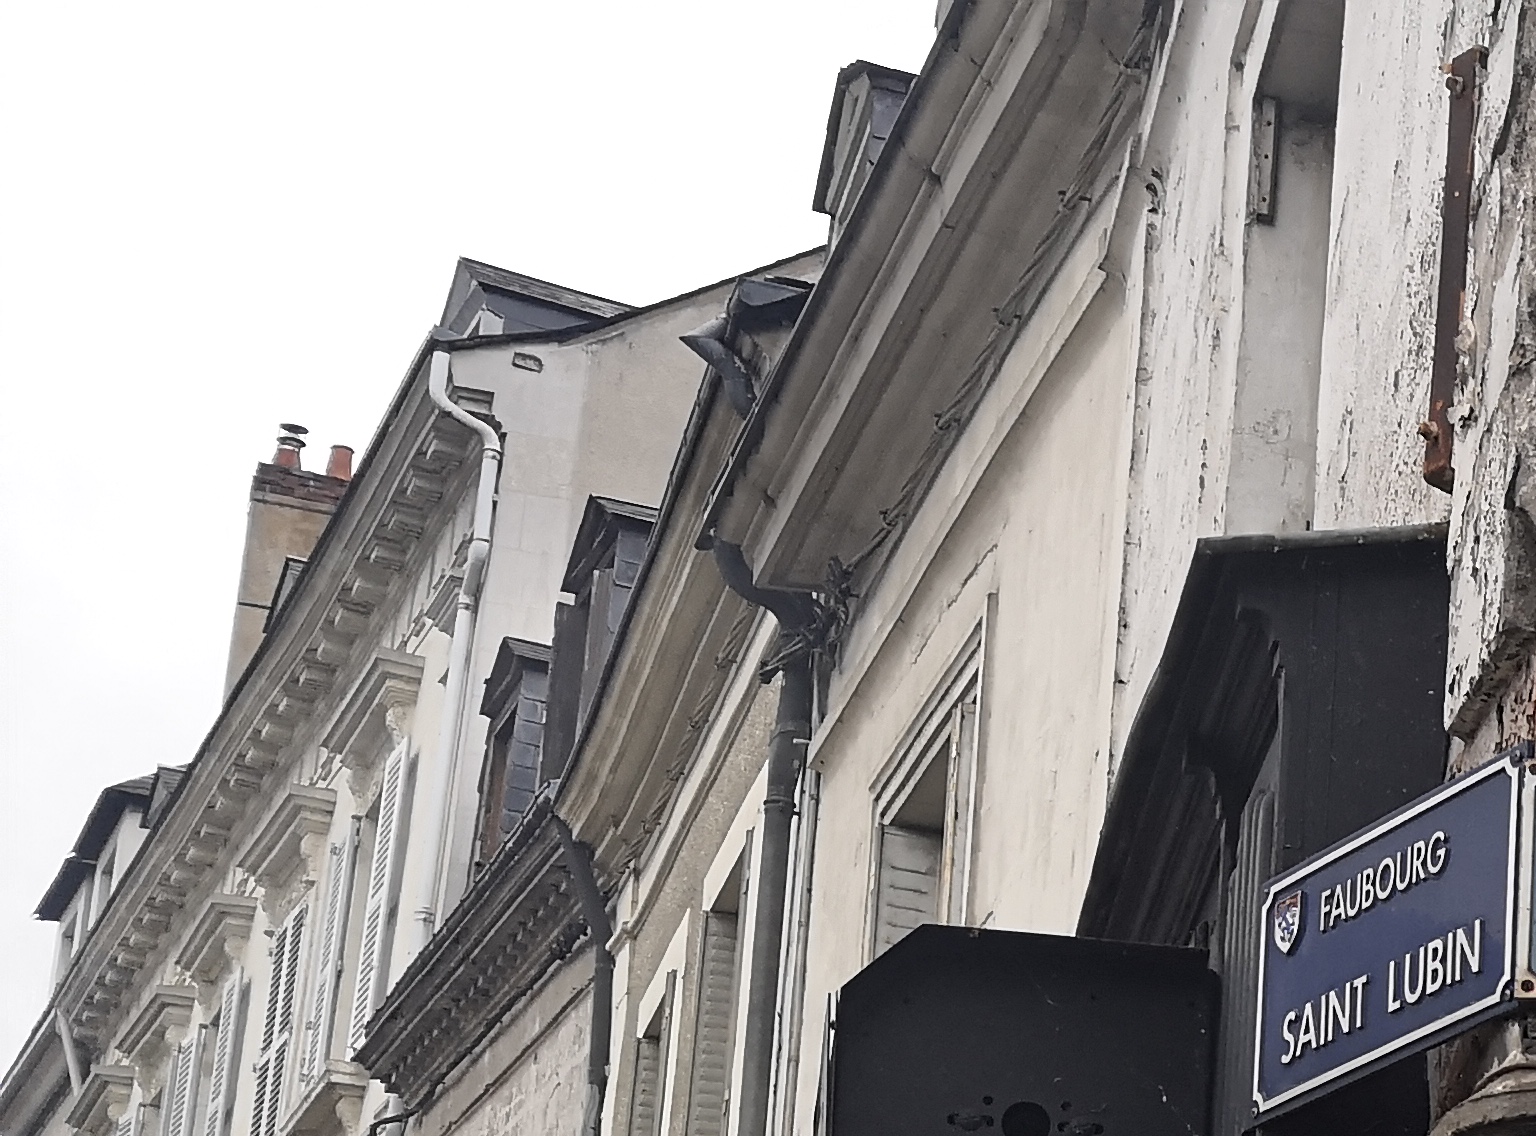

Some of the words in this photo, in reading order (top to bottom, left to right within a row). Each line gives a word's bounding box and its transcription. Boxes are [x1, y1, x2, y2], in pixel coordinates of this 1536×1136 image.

[1319, 830, 1448, 932] FAUBOURG
[1281, 973, 1369, 1064] SAINT
[1387, 917, 1481, 1013] LUBIN
